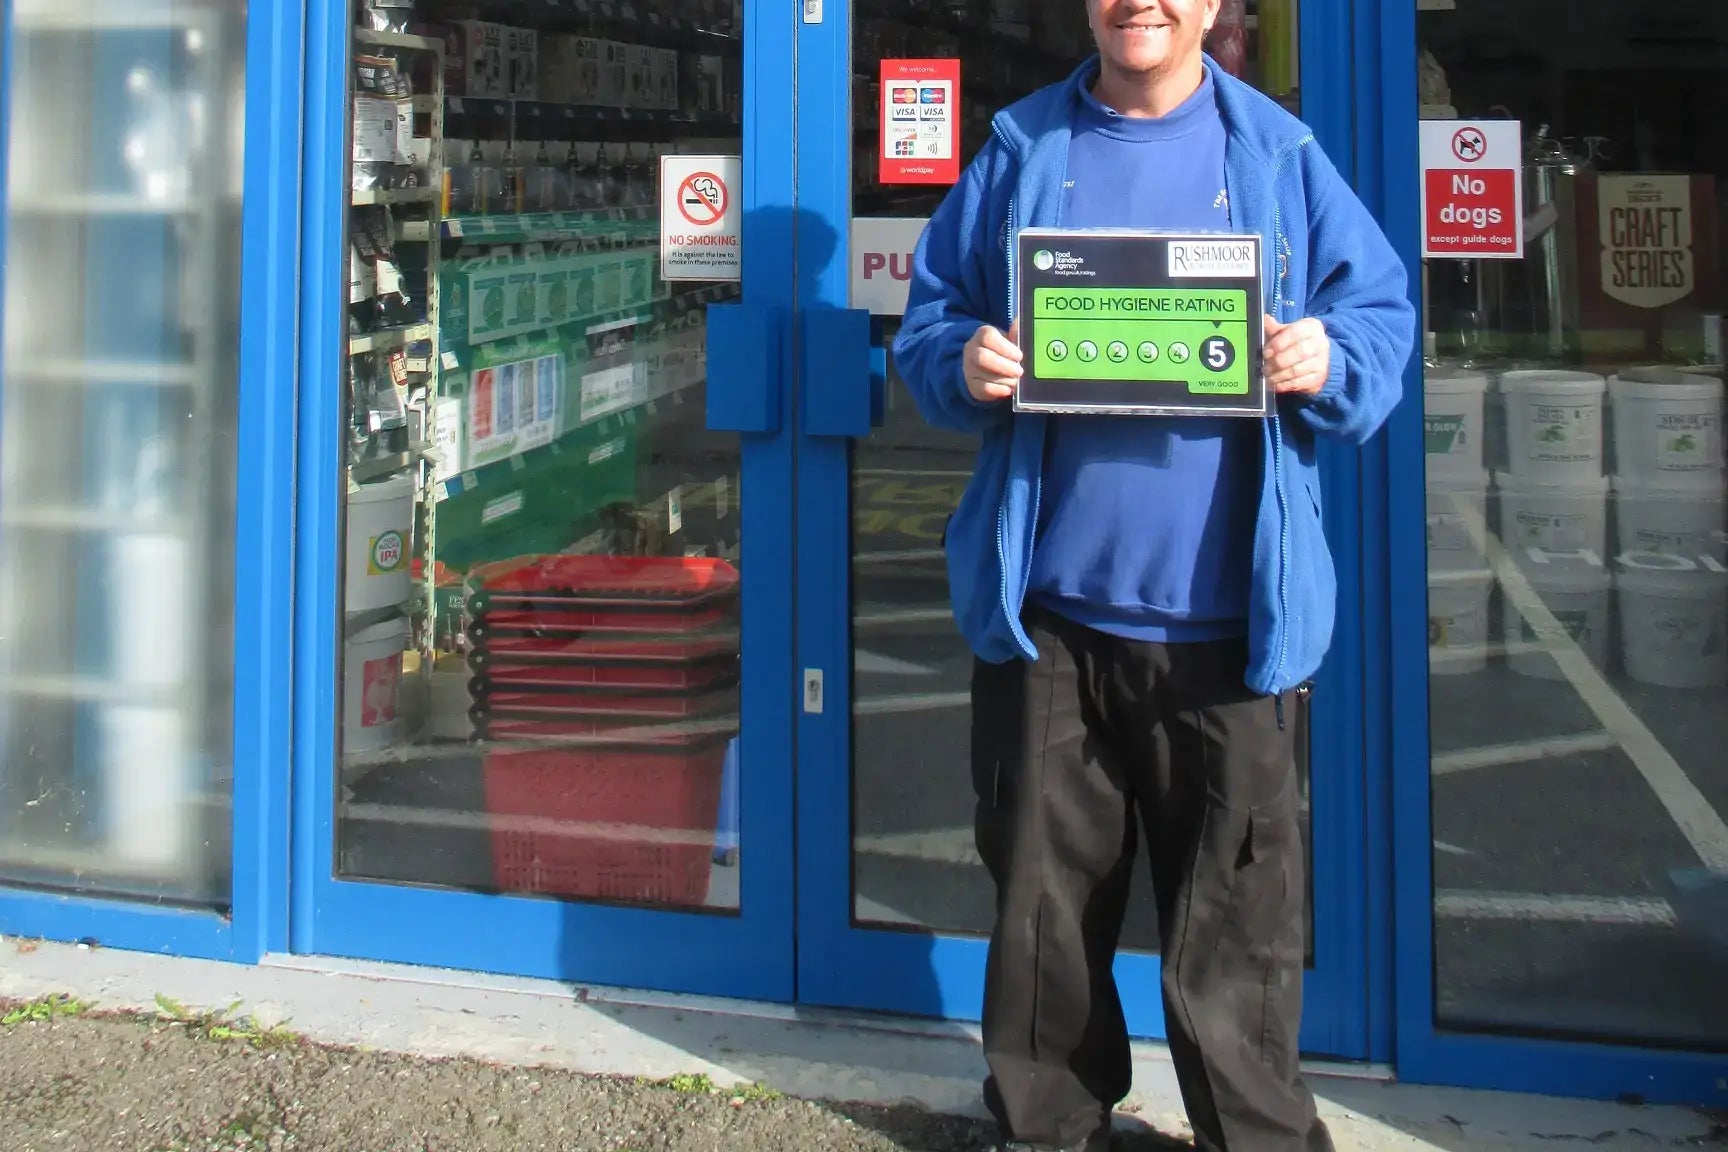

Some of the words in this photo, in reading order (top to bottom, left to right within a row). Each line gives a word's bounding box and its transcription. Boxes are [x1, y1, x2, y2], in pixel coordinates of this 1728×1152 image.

[896, 108, 916, 116] VISA
[924, 108, 944, 116] VISA
[1452, 174, 1486, 196] No
[1440, 202, 1502, 229] dogs
[1610, 207, 1683, 248] CRAFT
[669, 235, 685, 246] NO
[1431, 235, 1460, 244] except
[1462, 235, 1487, 245] guide
[1490, 235, 1513, 245] dogs
[863, 252, 914, 281] PU
[1055, 263, 1078, 271] Agency
[1174, 245, 1251, 272] RUSHMOOR
[1612, 250, 1685, 288] SERIES
[1045, 297, 1095, 311] FOOD
[1099, 297, 1171, 312] HYGIENE
[1174, 298, 1236, 313] RATING
[1112, 346, 1123, 359] 2
[1207, 340, 1227, 368] 5
[380, 549, 398, 562] IPA
